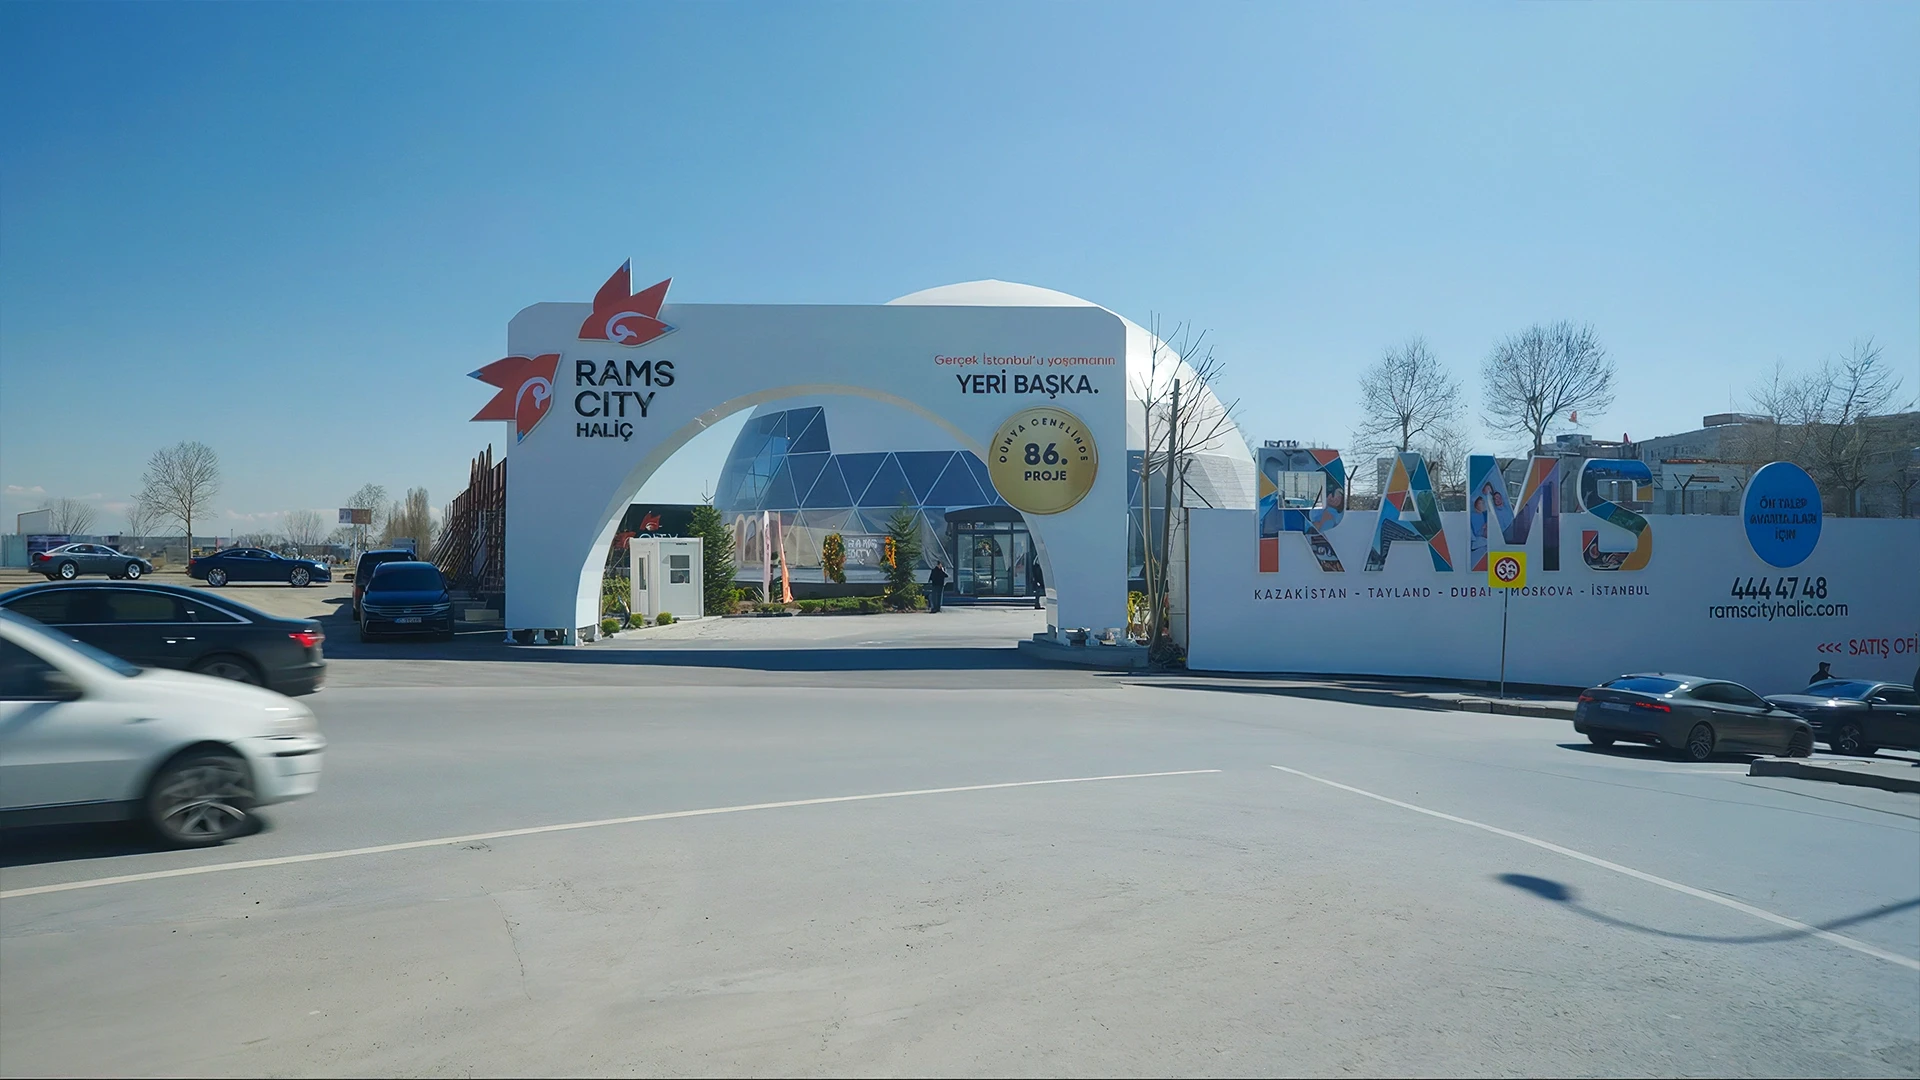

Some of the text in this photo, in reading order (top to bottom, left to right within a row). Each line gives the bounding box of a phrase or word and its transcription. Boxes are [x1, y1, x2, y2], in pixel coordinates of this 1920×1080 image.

[934, 354, 979, 367] Gerçek
[575, 360, 675, 387] RAMS
[956, 369, 1099, 399] YERİ BAŞKA.
[574, 390, 656, 418] CITY
[576, 420, 634, 441] HALİÇ
[1024, 442, 1068, 466] 86.
[1024, 470, 1067, 481] PROJE
[1255, 447, 1655, 574] RAMS
[1254, 586, 1347, 600] KAZAKİSTAN
[1367, 587, 1431, 598] TAYLAND
[1511, 586, 1574, 597] MOSKOVA
[1591, 584, 1650, 596] İSTANBUL
[1731, 577, 1828, 600] 444 47 48
[1709, 600, 1848, 621] ramscityhalic.com
[1848, 638, 1890, 659] SATIŞ
